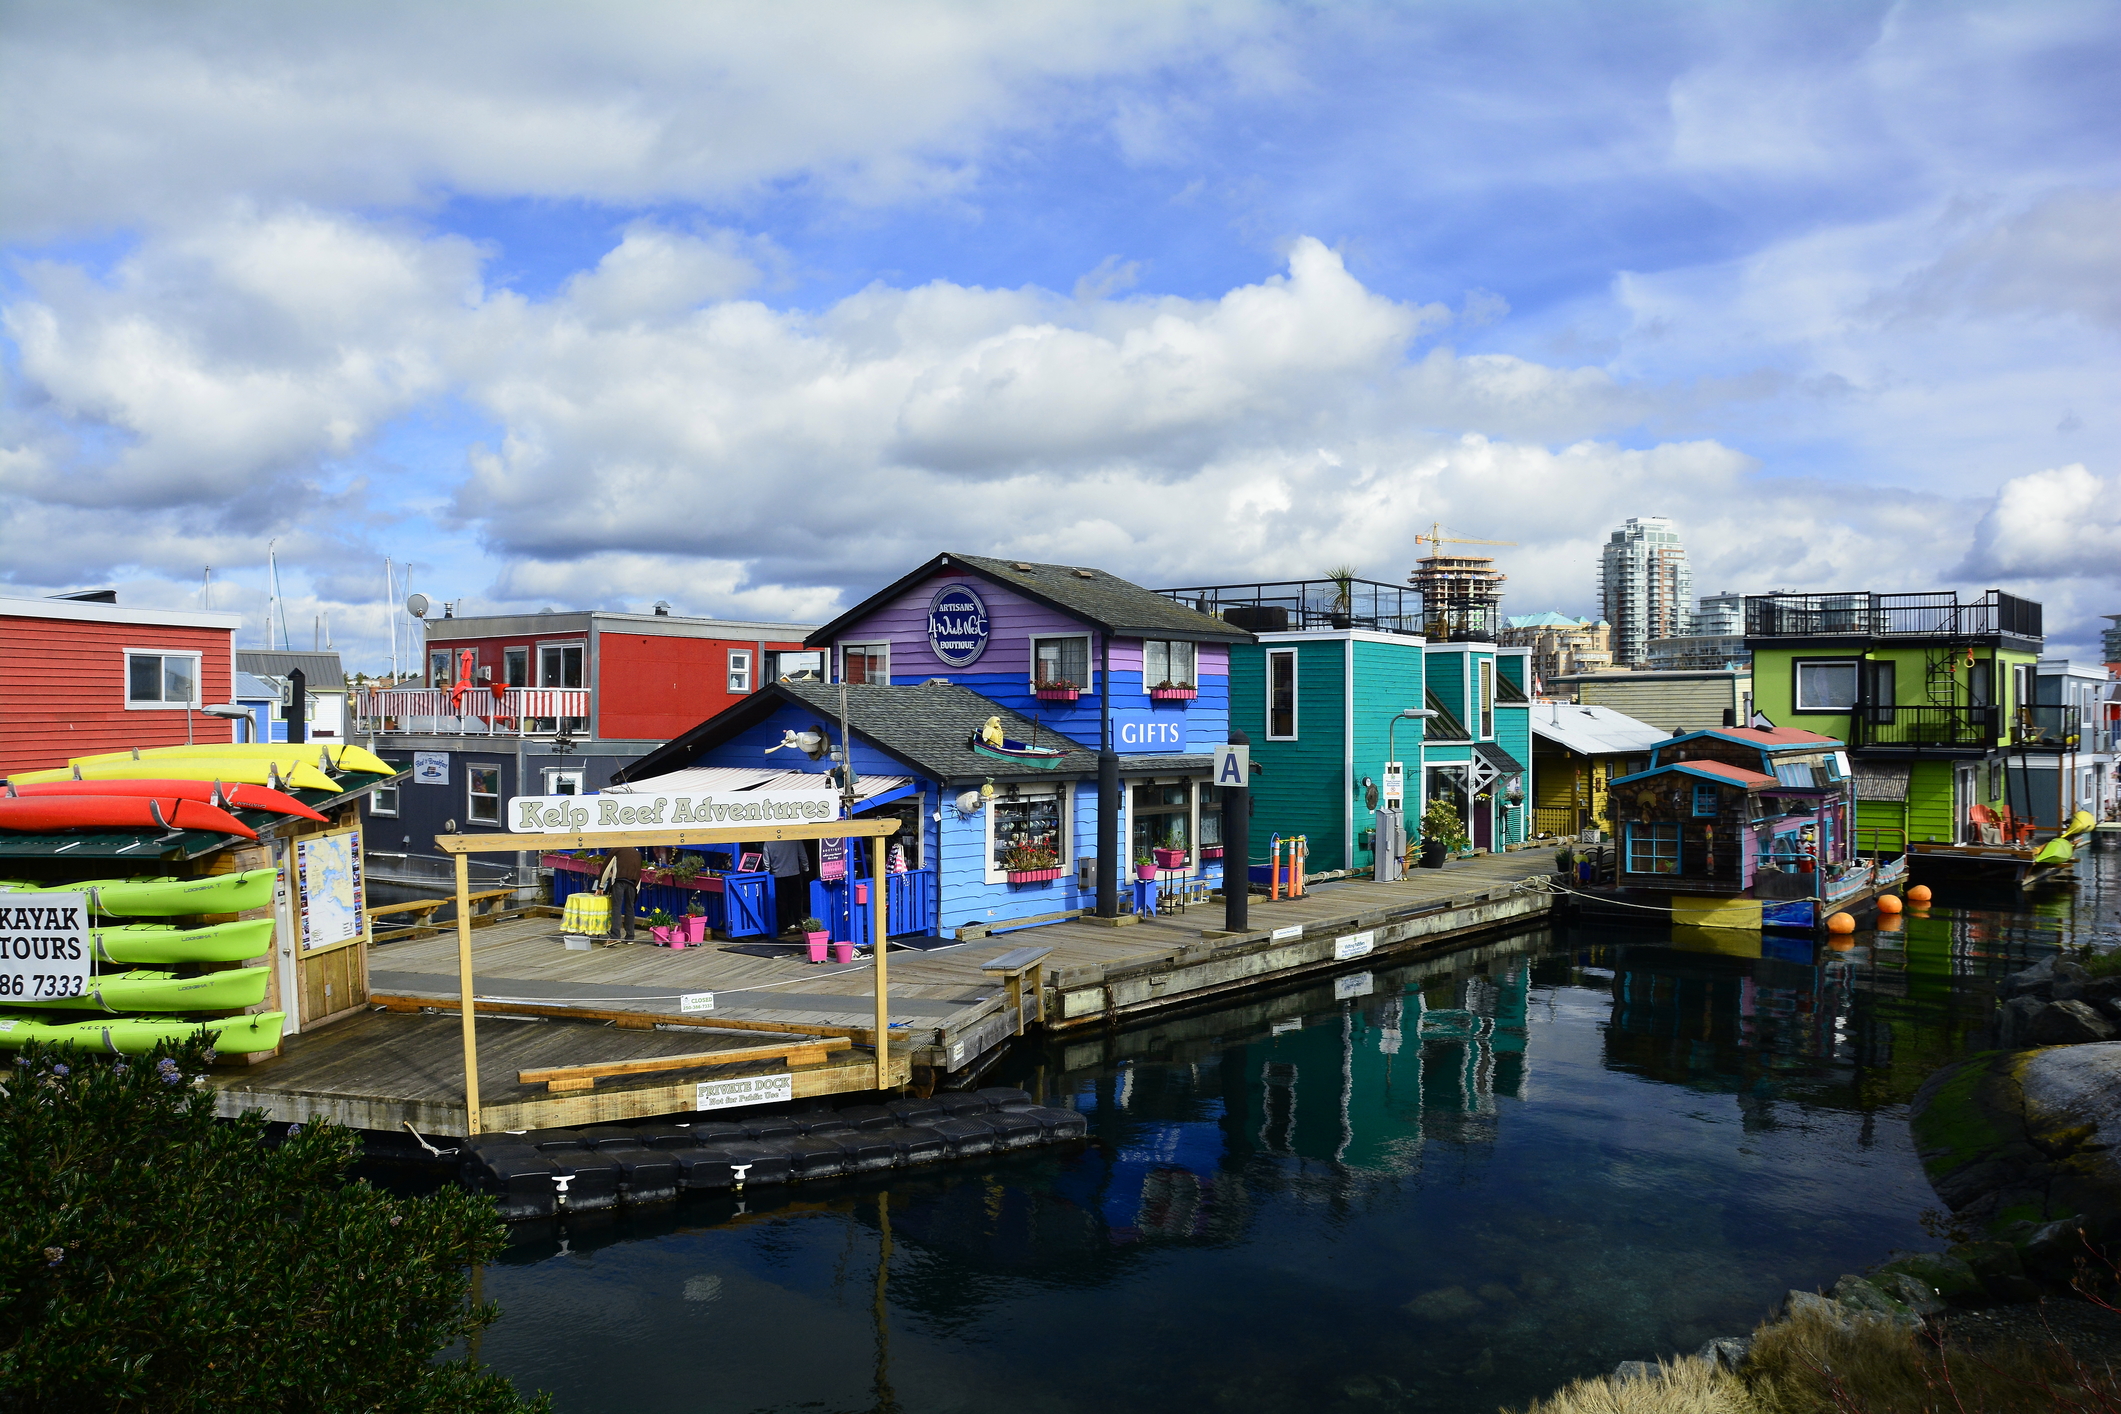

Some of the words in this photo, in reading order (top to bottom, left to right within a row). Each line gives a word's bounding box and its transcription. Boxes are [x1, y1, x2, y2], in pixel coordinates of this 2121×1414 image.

[939, 603, 975, 612] ARTISANS
[940, 641, 975, 650] BOUTIQUE
[283, 685, 290, 704] B
[1121, 723, 1179, 744] GIFTS
[1220, 753, 1242, 784] A
[518, 799, 590, 833] Kelp
[597, 797, 668, 826] Reef
[671, 796, 831, 824] Adventures
[0, 907, 79, 930] KAYAK
[0, 937, 81, 960] TOURS
[0, 974, 24, 995] 86
[33, 974, 83, 996] 7333
[691, 996, 713, 1004] CLOSED
[698, 1081, 752, 1097] PRIVATE
[755, 1077, 791, 1091] DOCK
[709, 1098, 724, 1106] Not
[725, 1096, 737, 1104] for
[739, 1093, 763, 1102] Public
[764, 1091, 779, 1099] Use
